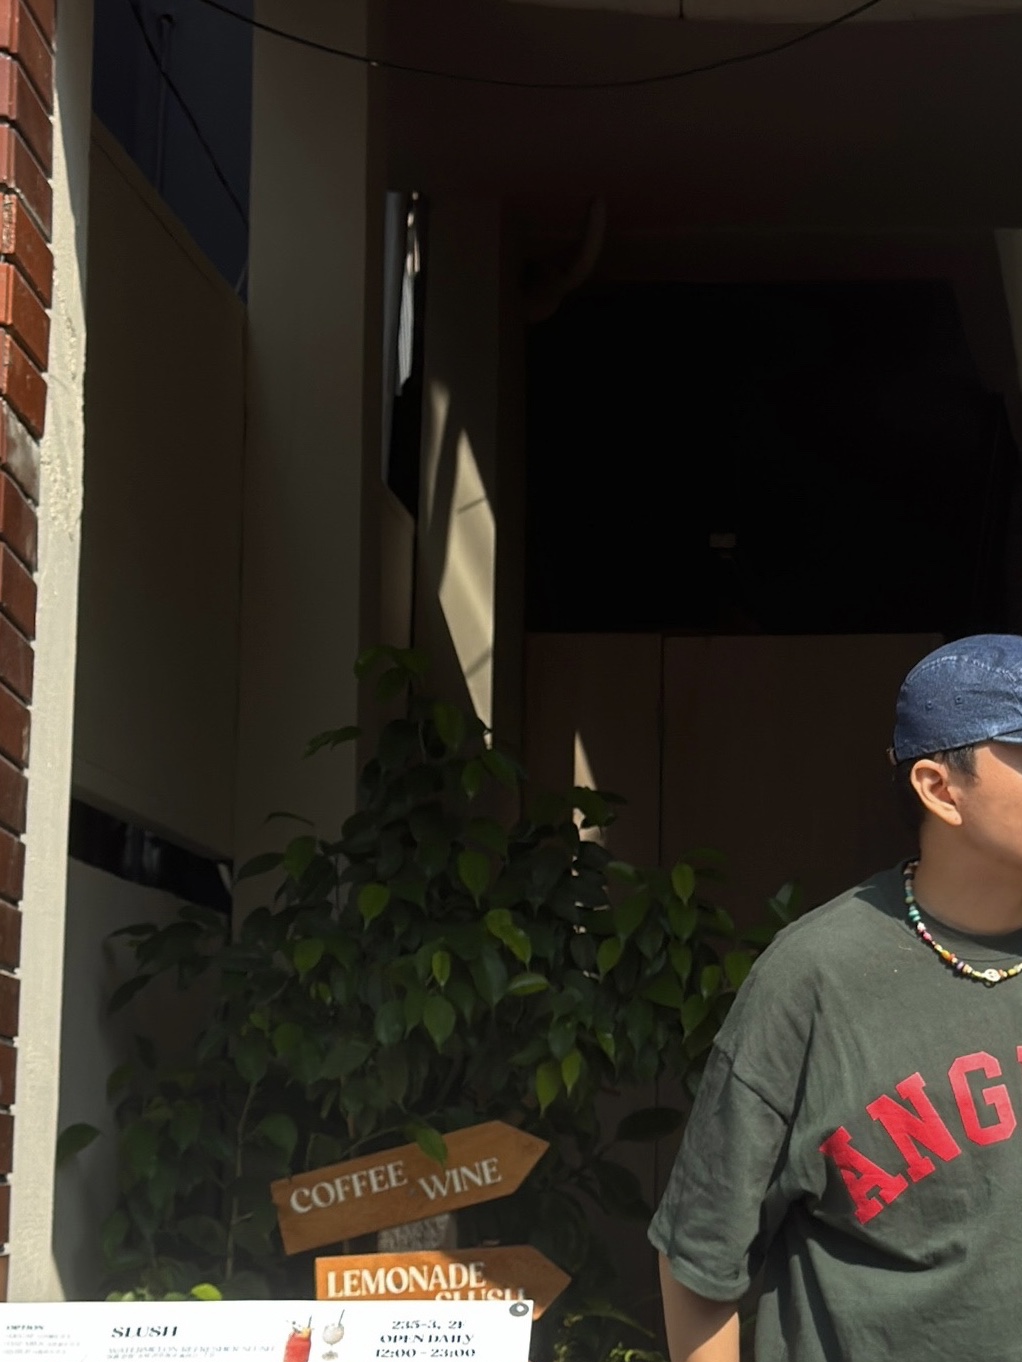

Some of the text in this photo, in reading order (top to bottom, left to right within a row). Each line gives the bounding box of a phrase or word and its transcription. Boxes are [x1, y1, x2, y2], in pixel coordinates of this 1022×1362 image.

[290, 1156, 502, 1214] COFFEE WINE
[326, 1260, 487, 1299] LEMONADE
[111, 1325, 179, 1339] SLUSH
[380, 1334, 473, 1345] OPEN DAILY
[375, 1348, 417, 1358] 12:00
[430, 1348, 476, 1358] 23:00
